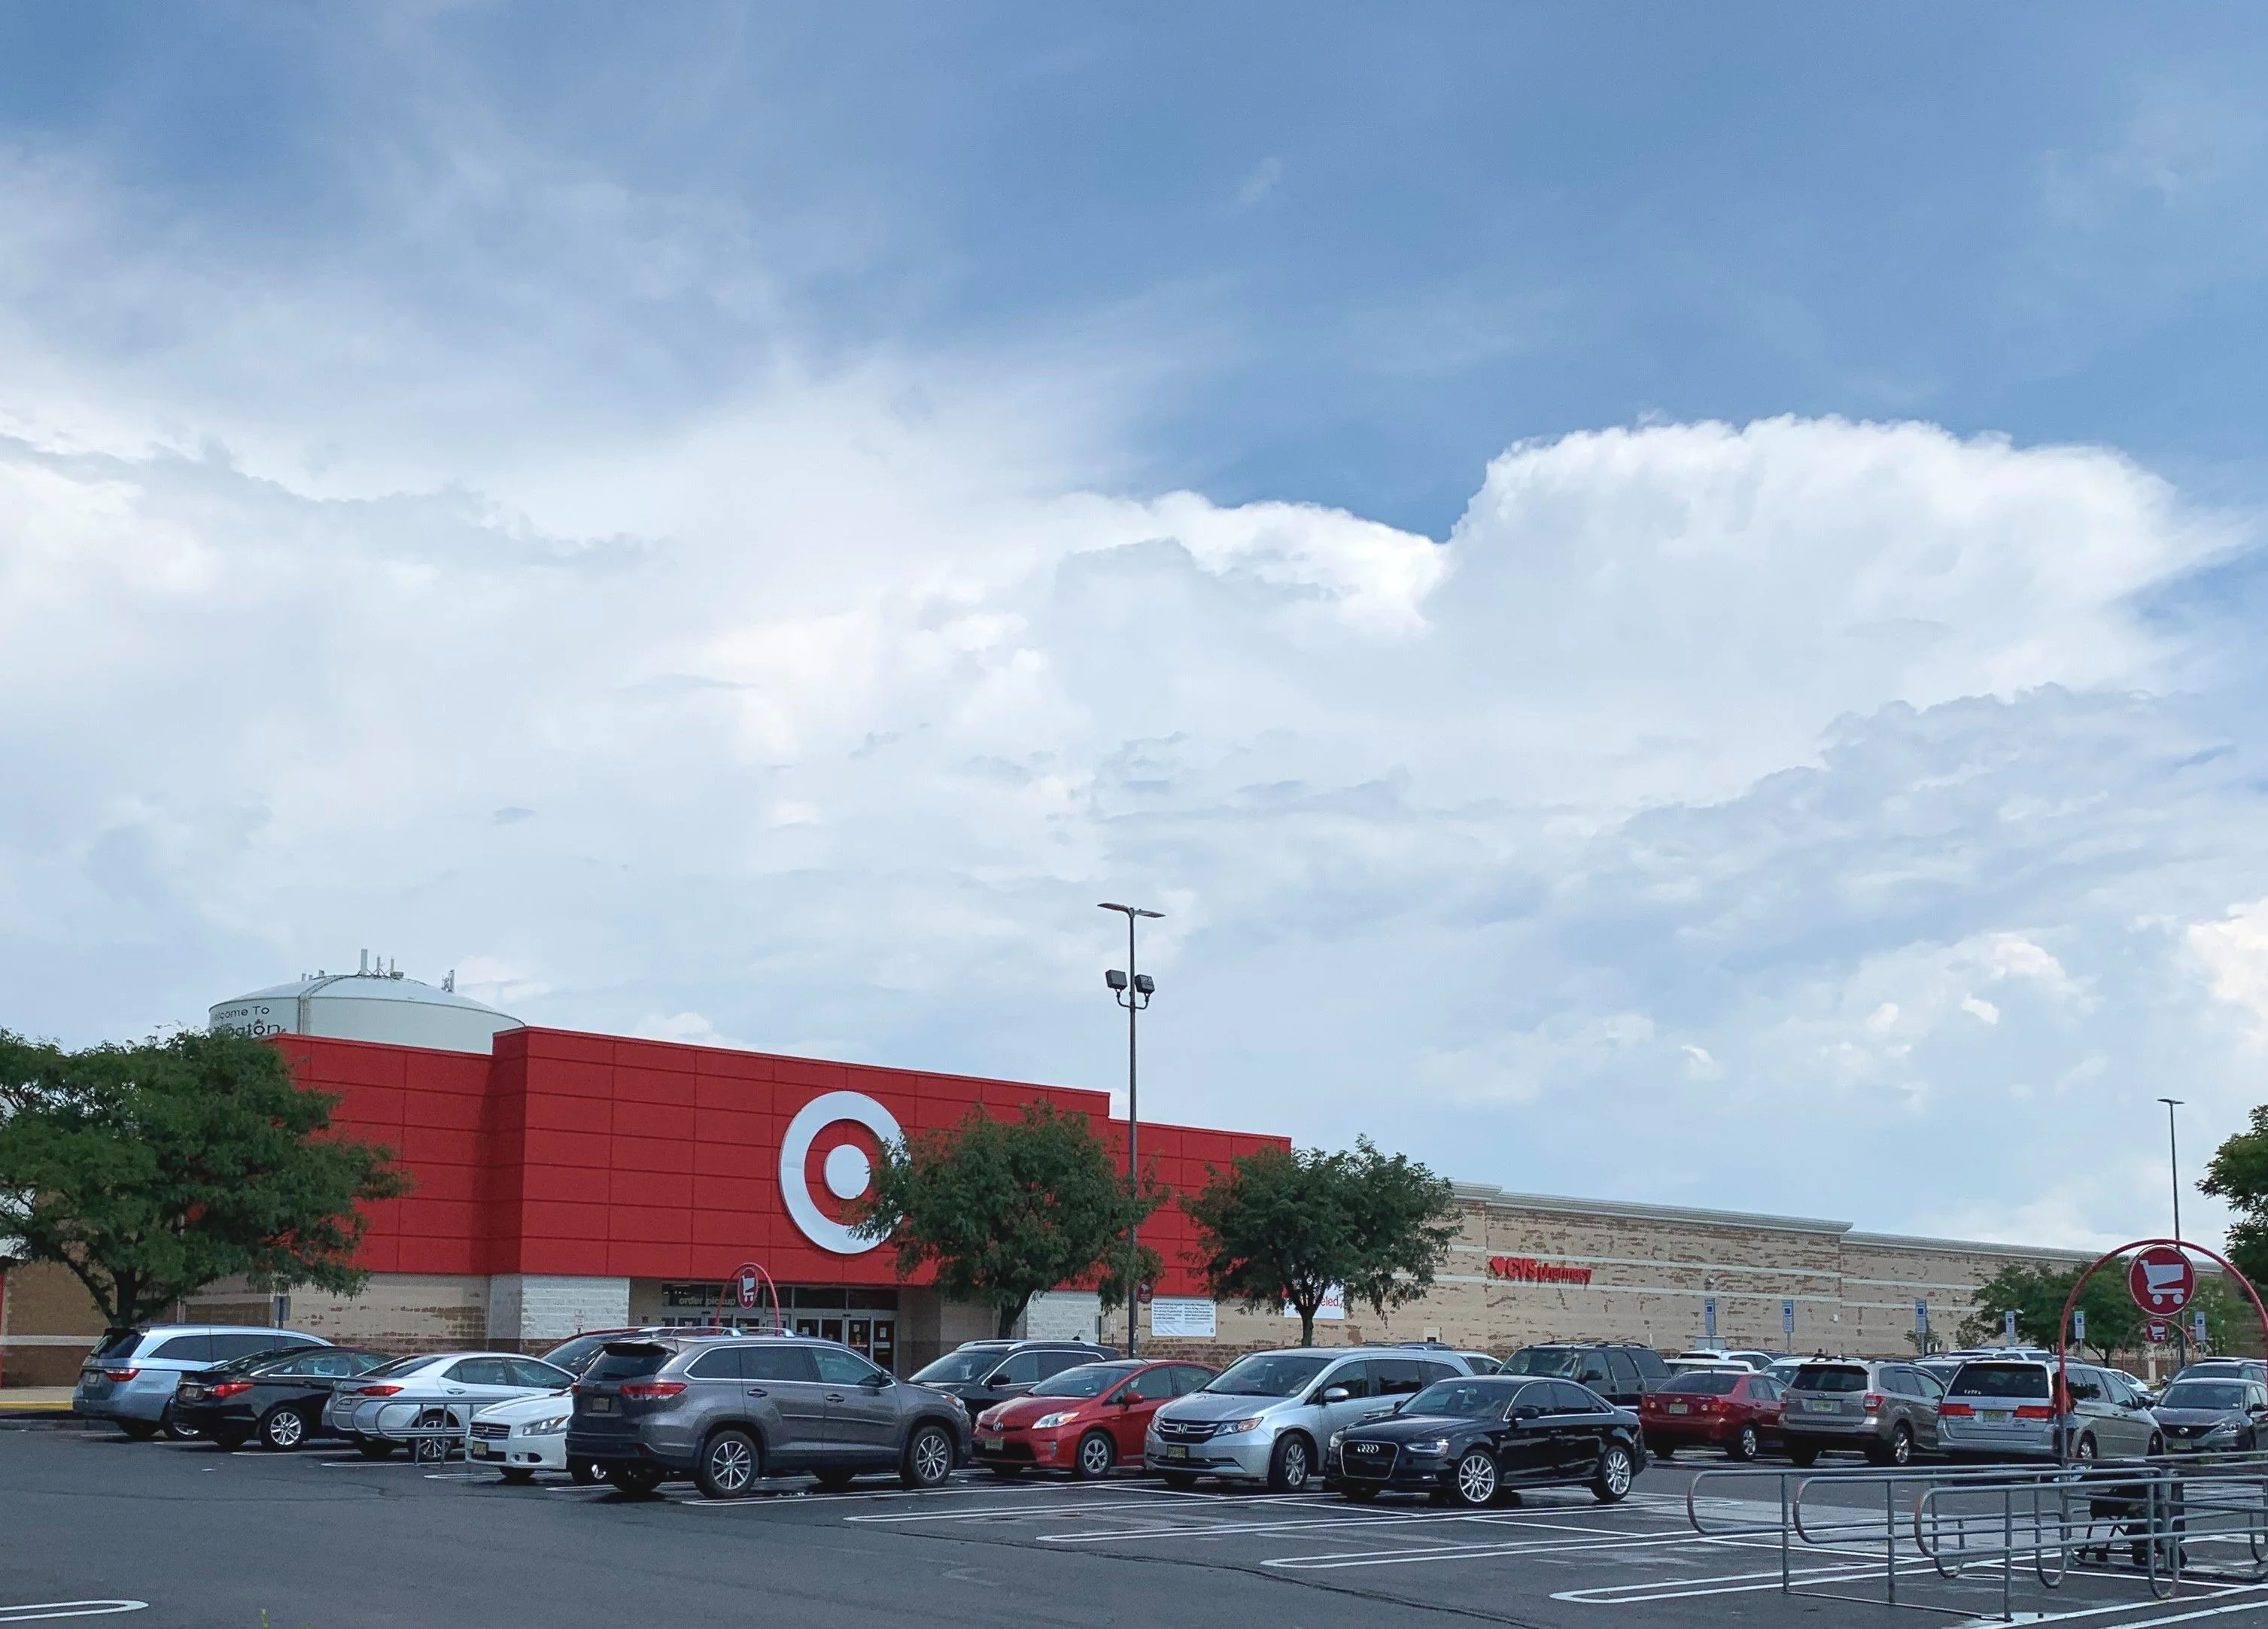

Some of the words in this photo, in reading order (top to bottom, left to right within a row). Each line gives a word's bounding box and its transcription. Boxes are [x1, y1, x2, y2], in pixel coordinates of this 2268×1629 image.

[214, 1008, 248, 1021] elcome
[252, 1005, 270, 1015] To
[1506, 1257, 1537, 1280] CVS
[1537, 1264, 1592, 1284] pharmacy
[679, 1296, 703, 1305] order
[705, 1296, 736, 1307] picup
